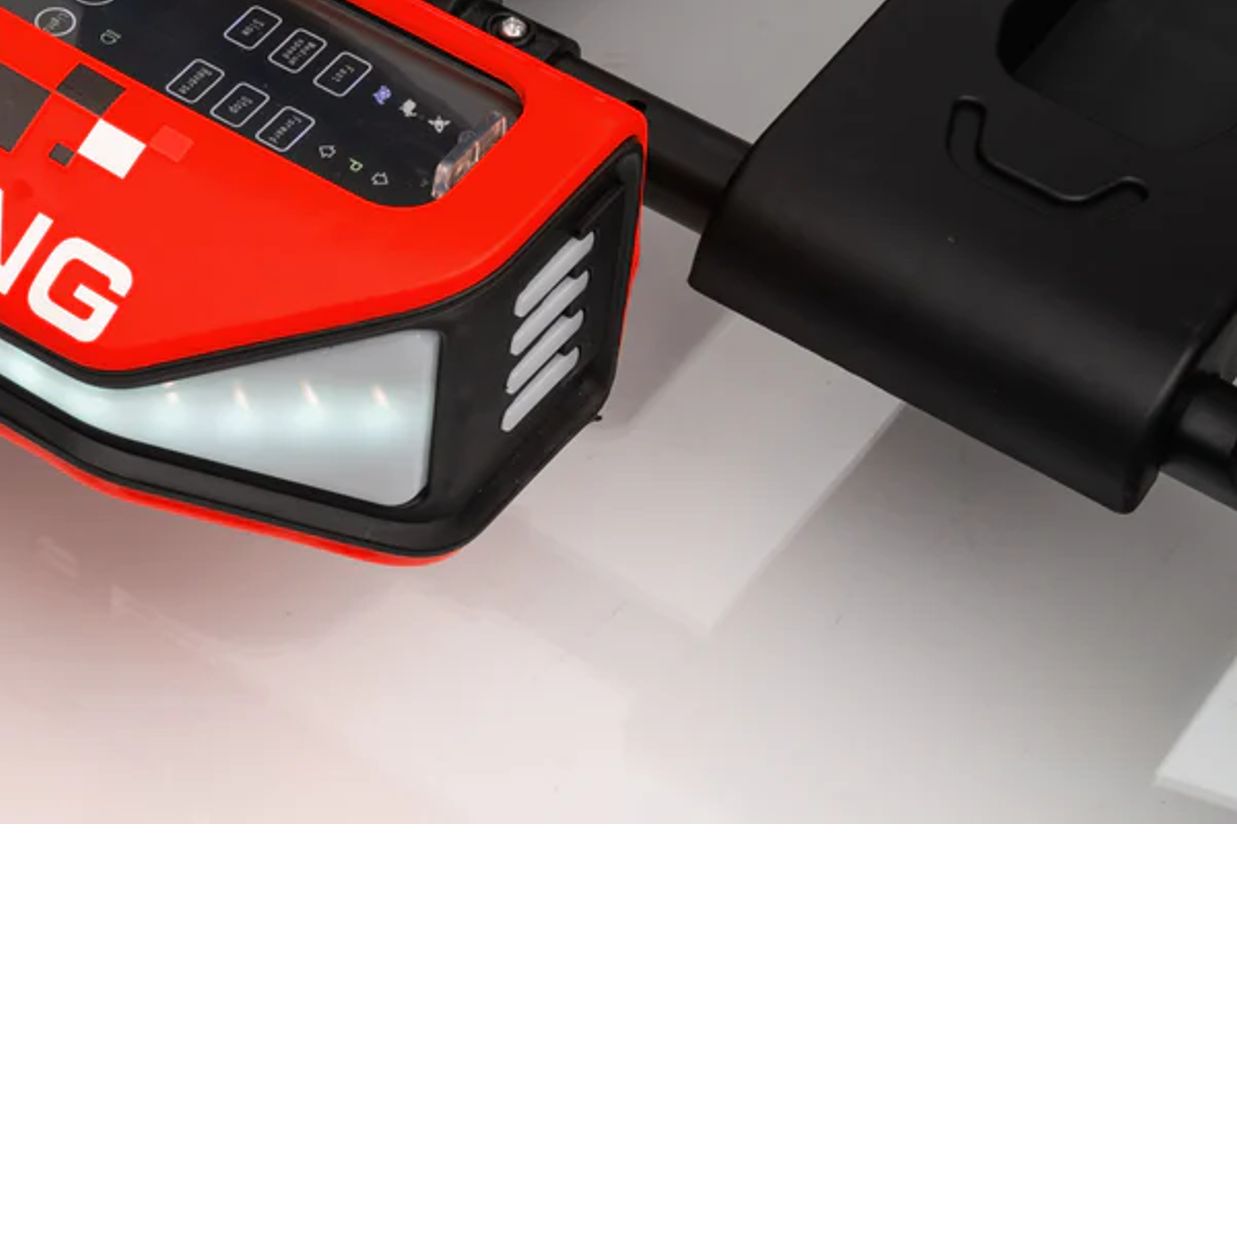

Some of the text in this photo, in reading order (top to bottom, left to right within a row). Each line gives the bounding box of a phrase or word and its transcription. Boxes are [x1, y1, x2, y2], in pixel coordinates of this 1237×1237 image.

[241, 18, 265, 37] Slow
[288, 42, 317, 66] Medium
[178, 67, 213, 95] Reverse
[331, 64, 355, 83] Fast
[229, 95, 253, 114] Stop
[268, 115, 303, 144] Forward
[348, 158, 363, 172] P
